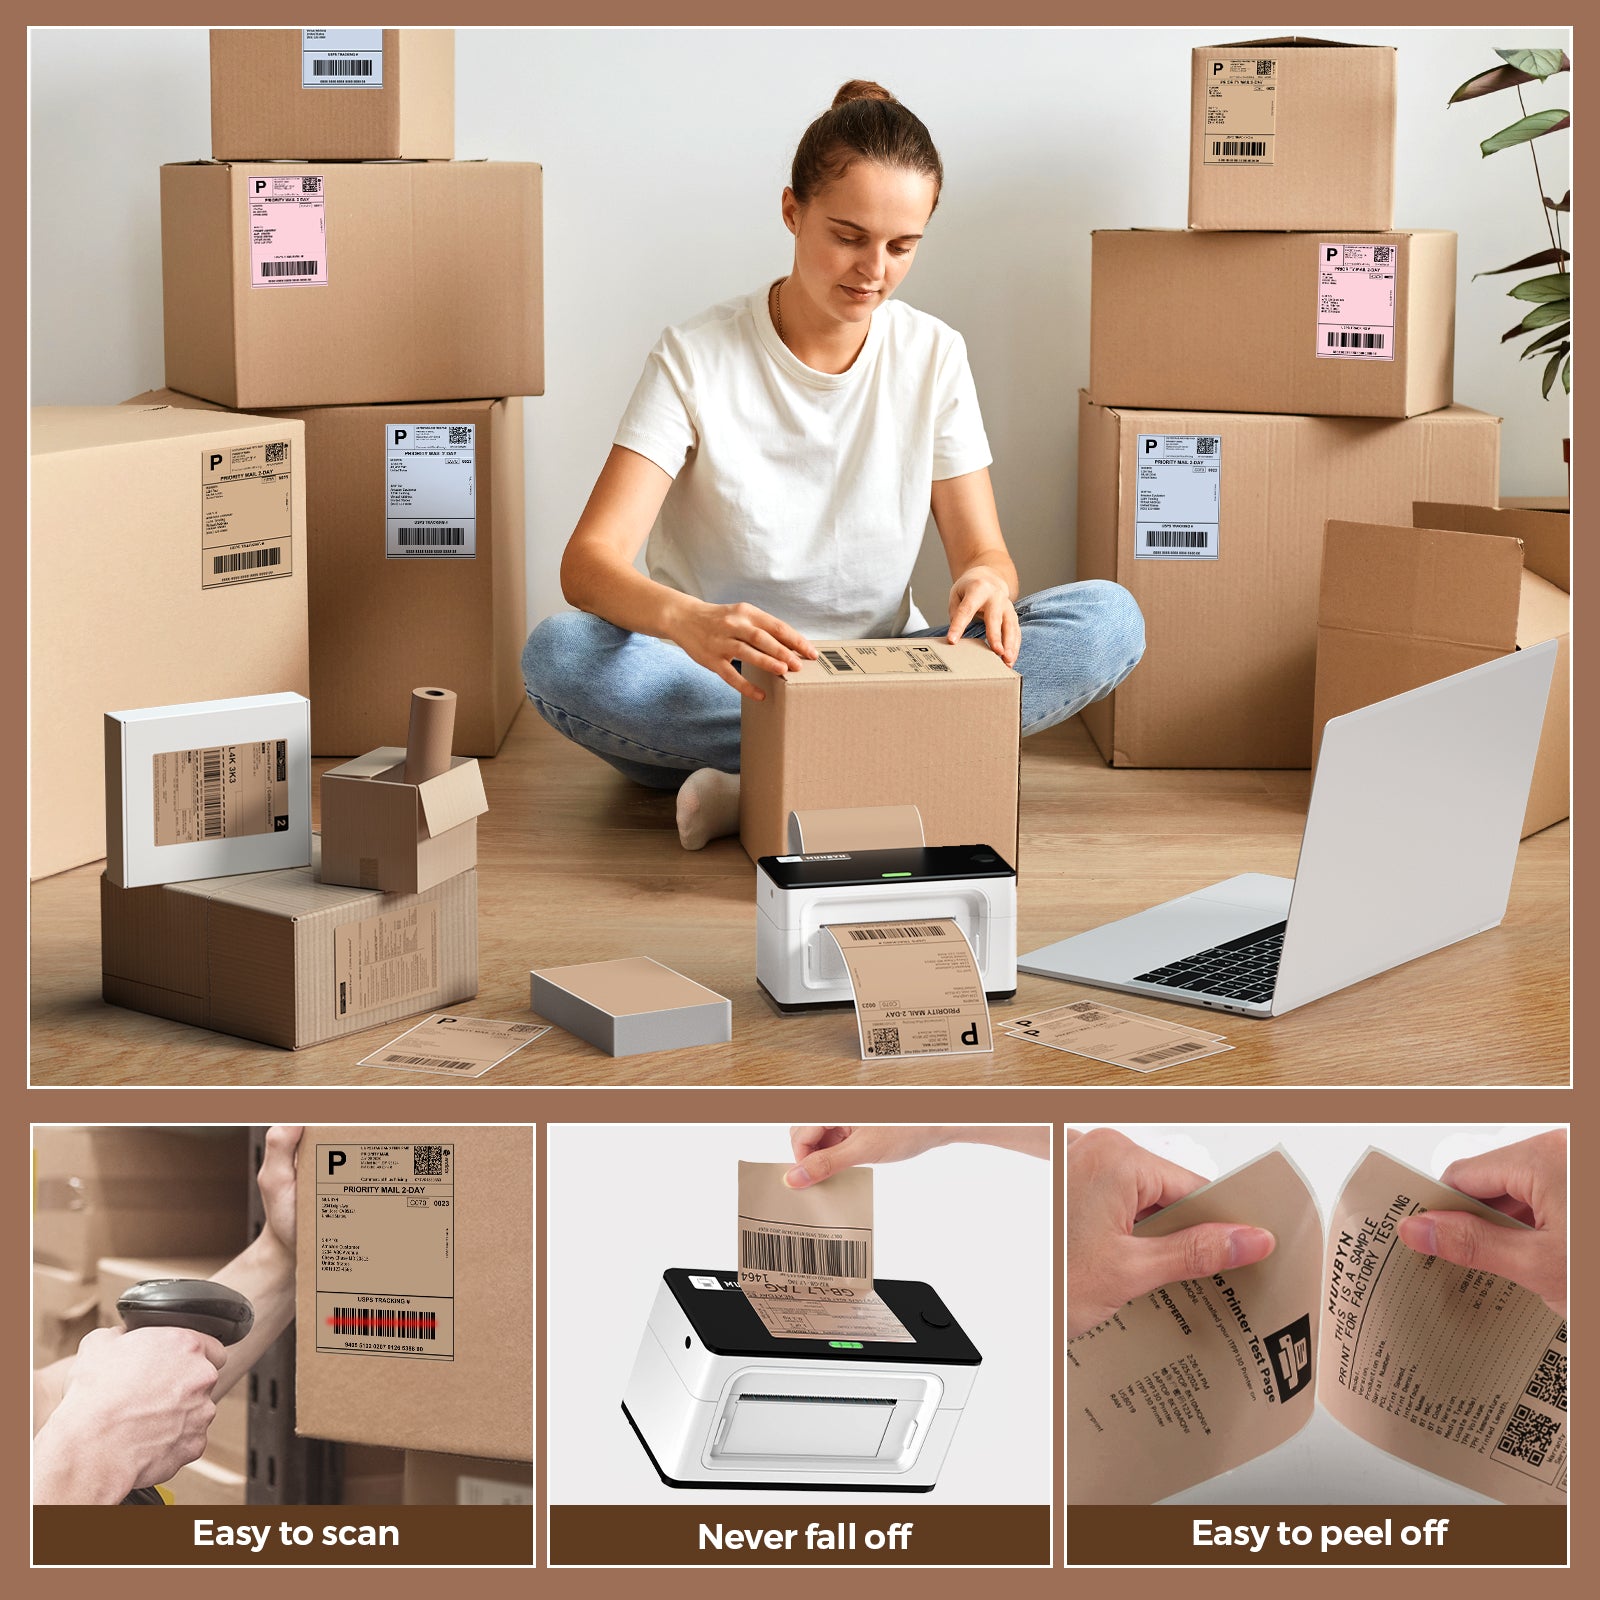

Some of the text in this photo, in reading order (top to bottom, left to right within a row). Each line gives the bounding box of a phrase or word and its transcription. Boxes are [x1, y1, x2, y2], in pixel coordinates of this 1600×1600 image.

[1213, 63, 1223, 75] P
[256, 180, 266, 193] P
[1327, 248, 1338, 261] P
[394, 430, 407, 445] P
[1145, 439, 1157, 453] P
[210, 454, 222, 471] P
[961, 1022, 979, 1046] P
[328, 1151, 346, 1175] P
[741, 1272, 769, 1282] 1464
[1328, 1230, 1354, 1315] MUNBYN
[1335, 1217, 1379, 1342] THIS IS A SAMPLE
[808, 1286, 854, 1297] GB-L7
[1338, 1194, 1411, 1386] PRINT FOR FACTORY TESTING
[1158, 1289, 1192, 1336] PROPERTIES
[1202, 1296, 1222, 1323] installed
[1216, 1321, 1229, 1339] your
[1228, 1339, 1244, 1367] ITPP130
[1240, 1366, 1253, 1391] Printer
[1250, 1392, 1257, 1401] on
[1222, 1287, 1252, 1334] Printer
[1248, 1335, 1266, 1366] Test
[1260, 1368, 1275, 1403] Page
[1201, 1378, 1210, 1390] PM
[1365, 1360, 1379, 1400] Production
[1372, 1380, 1382, 1404] Serial
[1394, 1364, 1417, 1416] Print Density
[1110, 1394, 1122, 1408] RAW
[1118, 1389, 1136, 1413] USB019
[1135, 1380, 1165, 1427] ITPP130 Printer
[1144, 1376, 1173, 1423] ITPP130 Printer
[1386, 1392, 1397, 1412] Print
[1403, 1384, 1420, 1419] Interface
[1410, 1414, 1417, 1424] BT
[1419, 1419, 1426, 1428] BT
[1424, 1402, 1432, 1416] MAC
[1427, 1403, 1442, 1431] BT Code
[1436, 1396, 1456, 1435] BT Version
[1444, 1400, 1464, 1439] Media Type
[1452, 1397, 1477, 1442] Locate Model
[1470, 1394, 1500, 1449] TPH Temperature
[1461, 1433, 1471, 1445] TPH
[1478, 1426, 1495, 1454] Printed
[1546, 1433, 1566, 1463] Warranty
